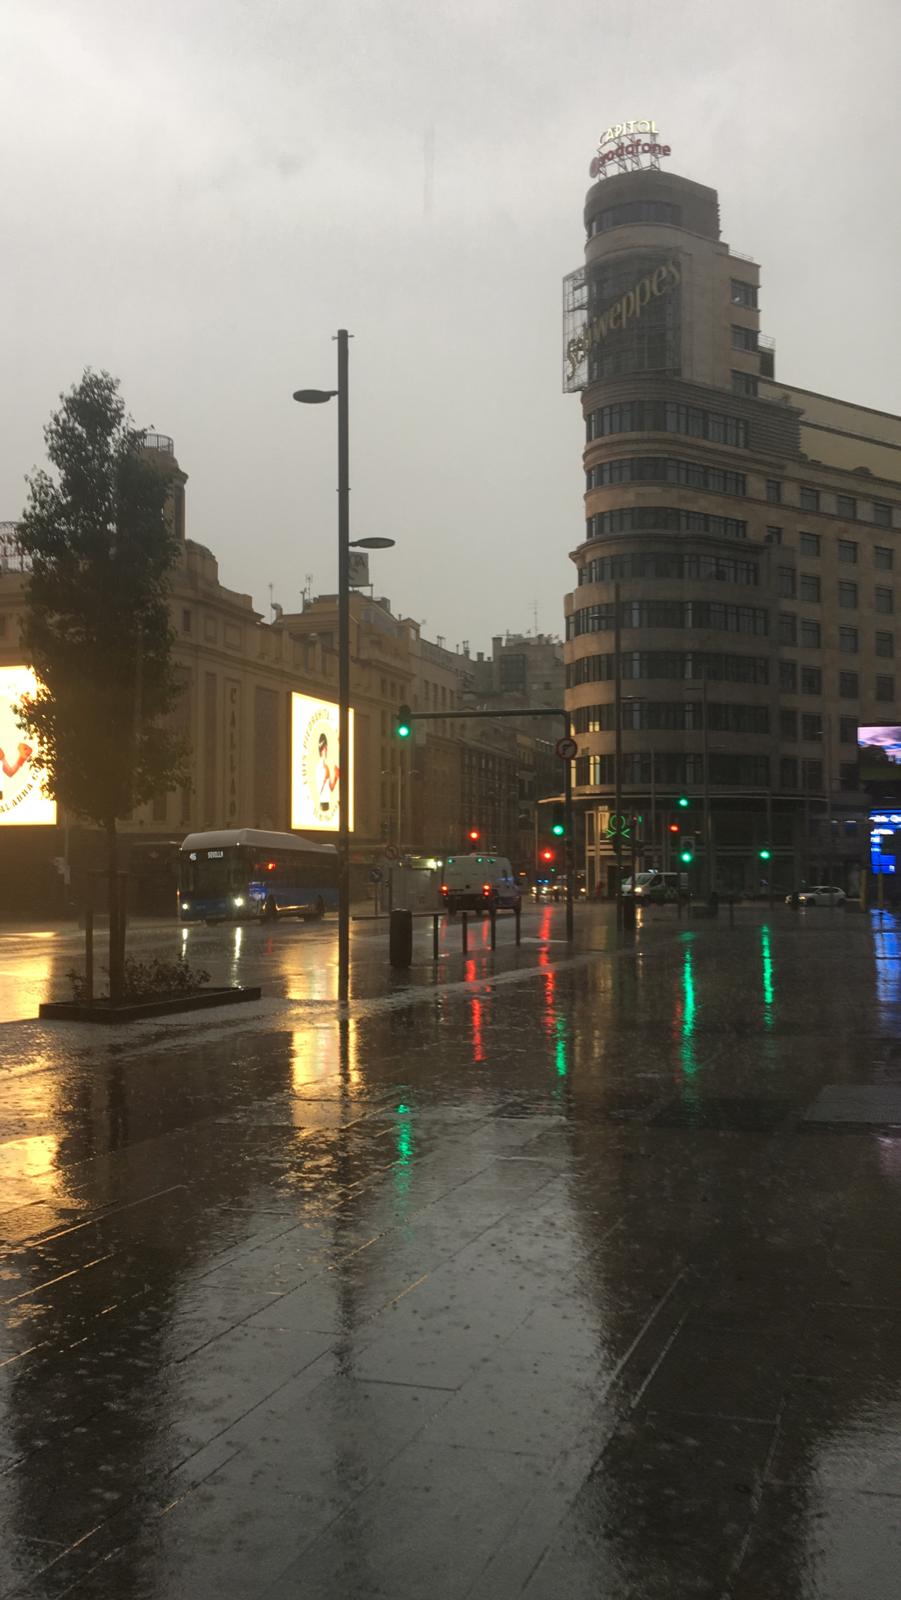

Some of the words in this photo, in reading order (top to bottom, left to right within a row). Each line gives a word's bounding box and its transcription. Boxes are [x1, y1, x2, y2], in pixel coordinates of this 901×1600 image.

[598, 139, 671, 168] vodafone
[600, 120, 659, 145] CAPITOL
[566, 264, 681, 382] Schweppes
[229, 687, 238, 817] CALLAO
